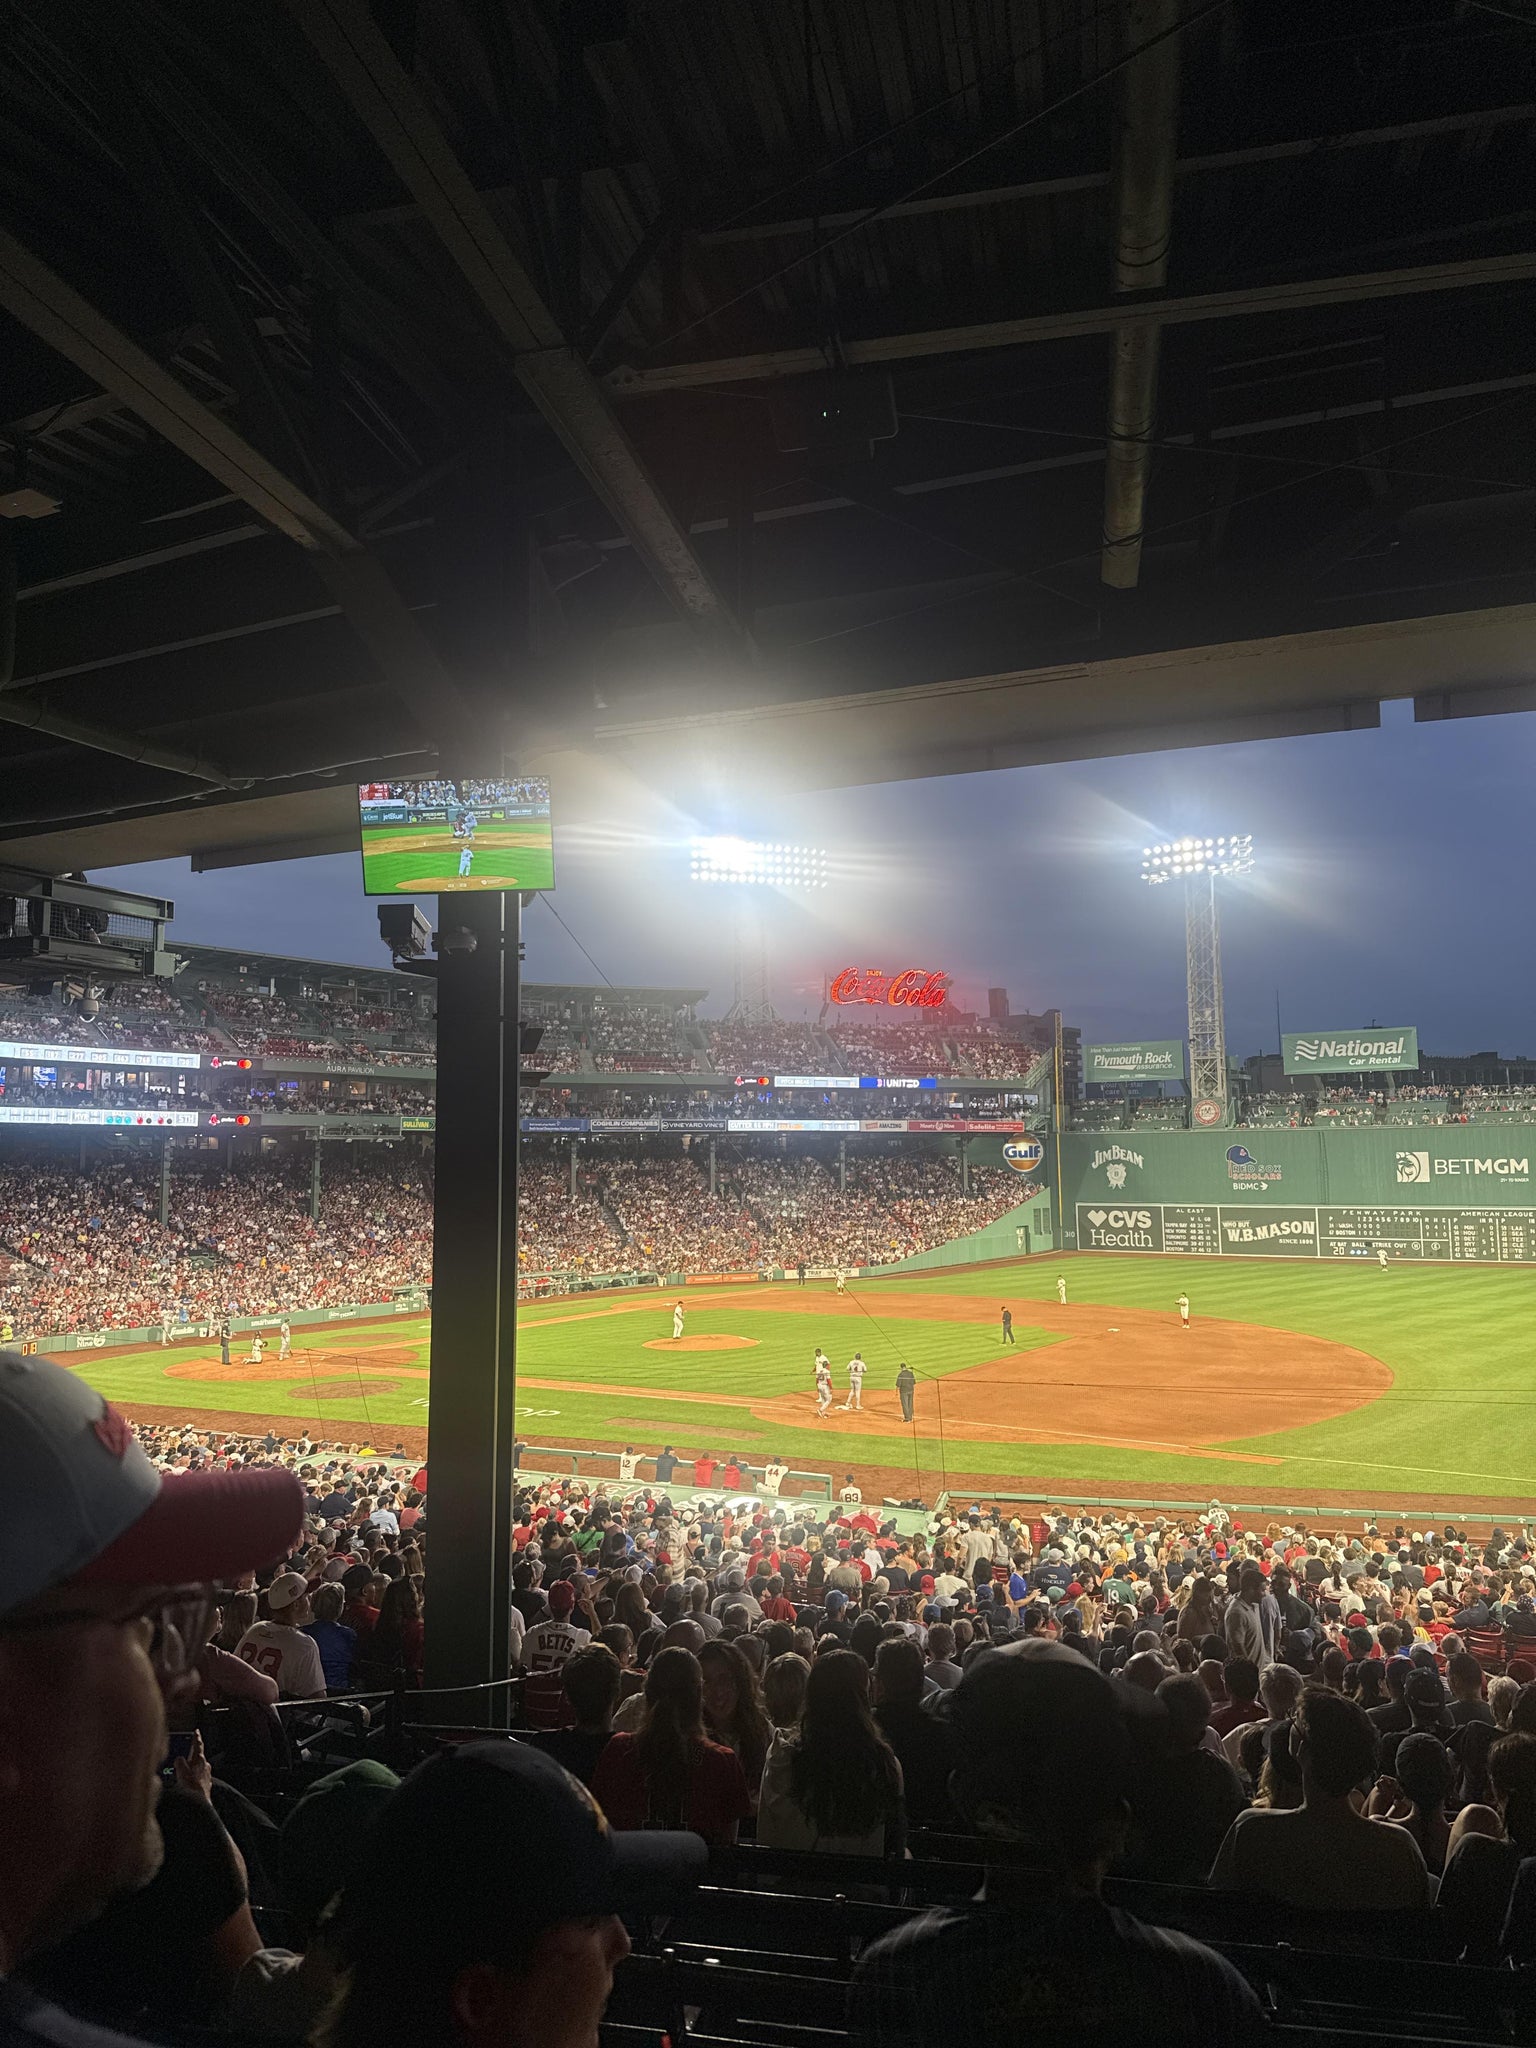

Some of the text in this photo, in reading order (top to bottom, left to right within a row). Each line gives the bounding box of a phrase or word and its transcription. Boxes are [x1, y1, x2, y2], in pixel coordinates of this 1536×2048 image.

[1319, 1037, 1404, 1057] National
[1094, 1052, 1172, 1067] Plymouth Rock
[1369, 1056, 1401, 1065] Rental
[327, 1065, 346, 1073] AURA
[886, 1079, 920, 1088] UNITED
[1004, 1145, 1041, 1158] Gulf
[1092, 1145, 1144, 1169] JIM BEAM
[1233, 1165, 1282, 1173] RED SOX
[1434, 1158, 1529, 1175] BETMGM
[1108, 1210, 1152, 1229] CVS
[1090, 1229, 1153, 1247] Health
[1333, 1247, 1345, 1256] 20
[250, 1318, 282, 1327] smartwater
[76, 1340, 94, 1348] Nine
[622, 1459, 631, 1468] 12
[767, 1468, 780, 1477] 44
[844, 1493, 859, 1503] 83
[1041, 1577, 1066, 1585] HINCKLEY
[1108, 1588, 1120, 1605] 19
[538, 1634, 576, 1654] BETTS
